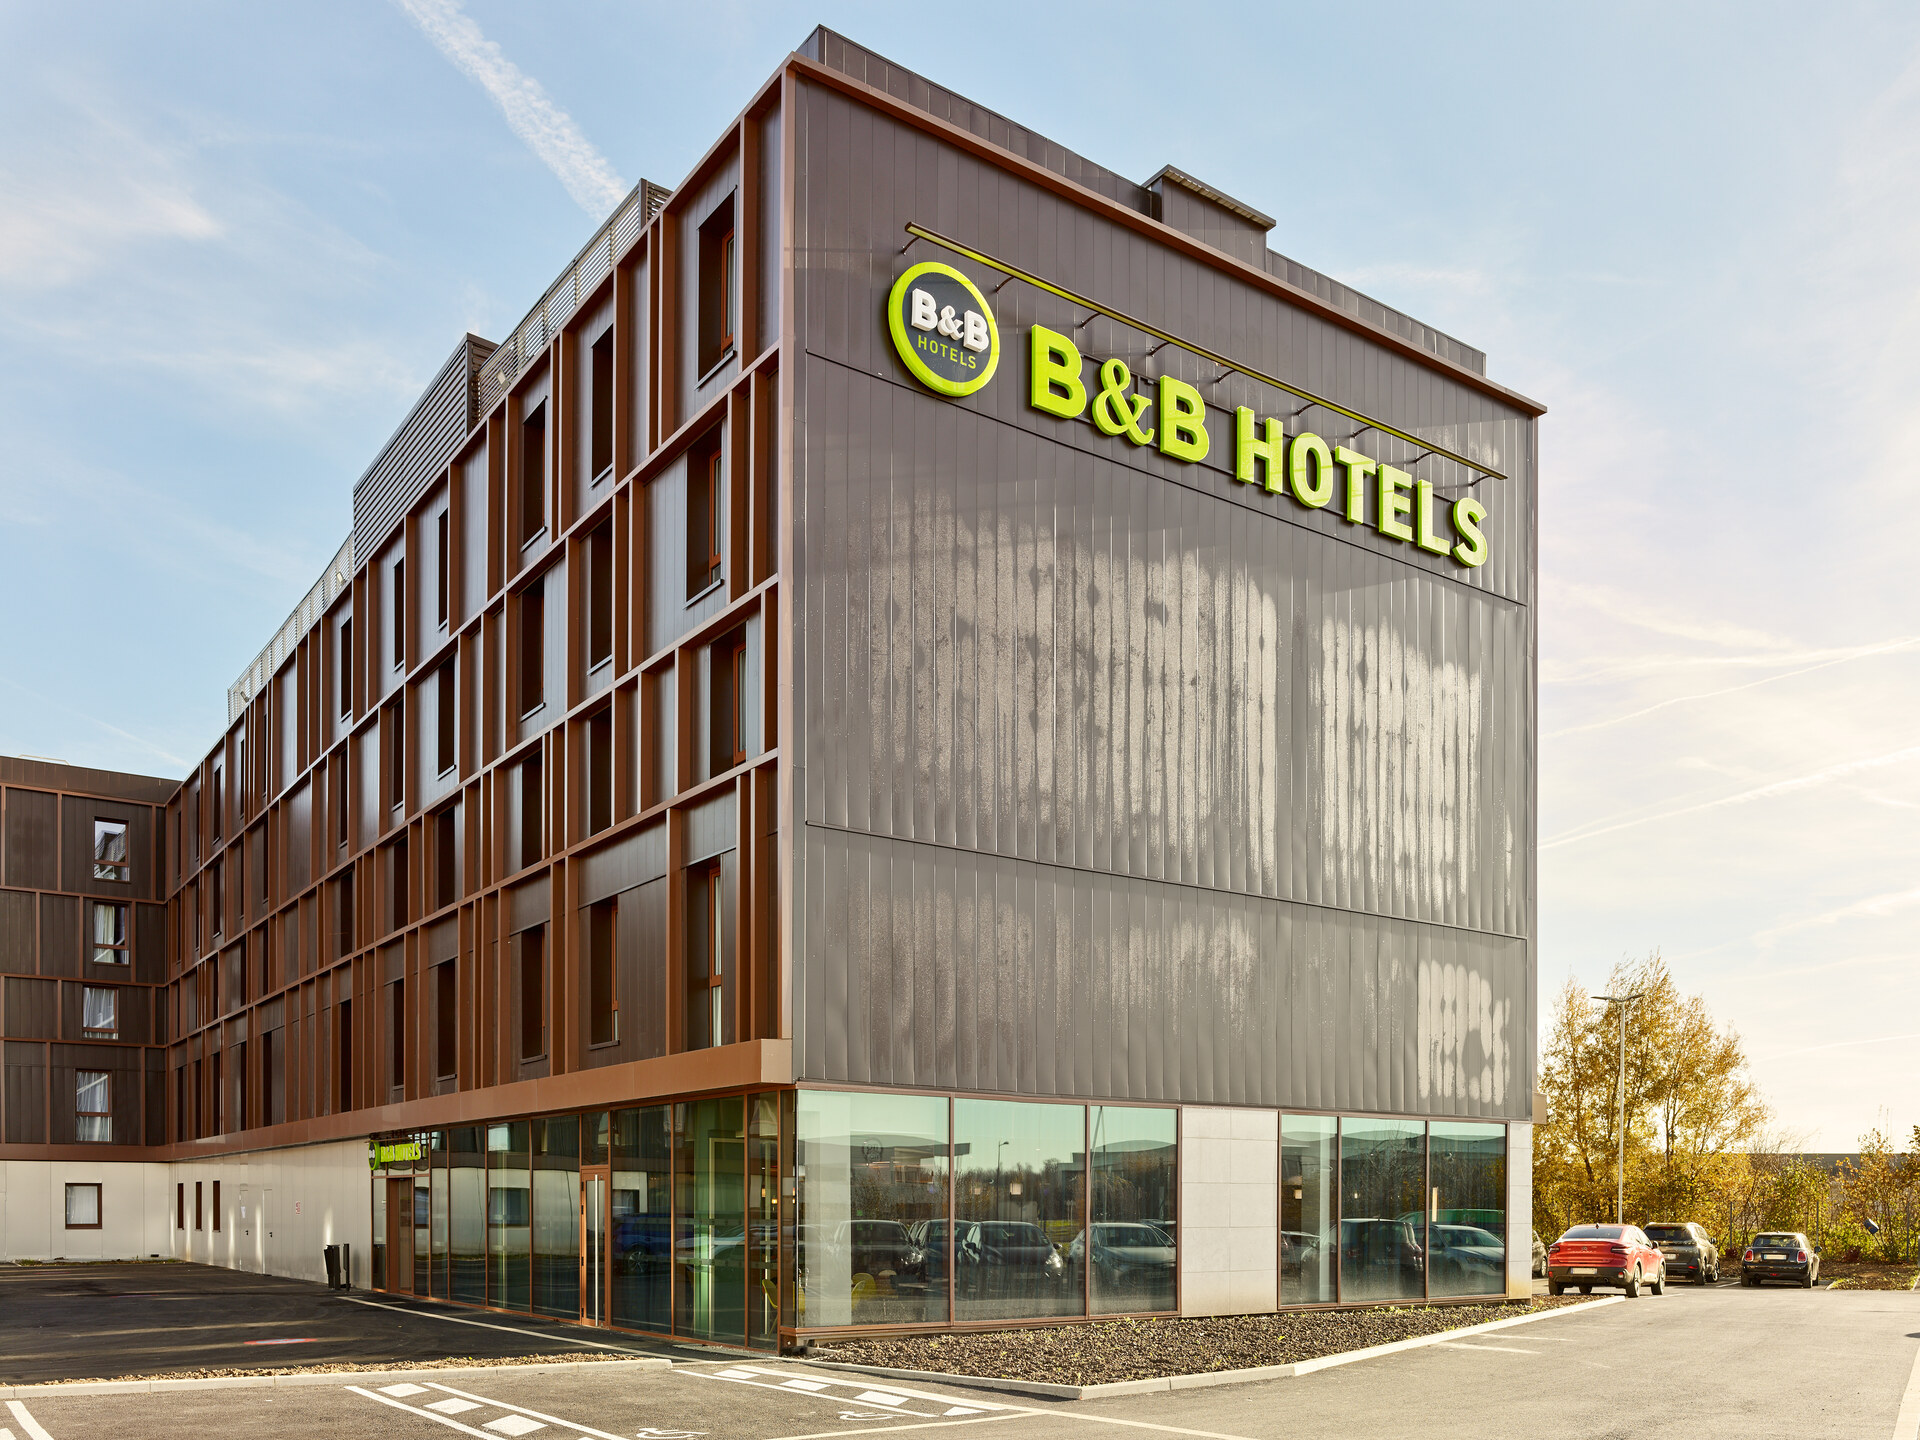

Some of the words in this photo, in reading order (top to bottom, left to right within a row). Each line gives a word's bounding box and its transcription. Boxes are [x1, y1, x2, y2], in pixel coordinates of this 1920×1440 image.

[911, 288, 989, 353] B&B
[918, 335, 977, 369] HOTELS
[1031, 324, 1210, 463] B&B
[1236, 406, 1488, 567] HOTELS
